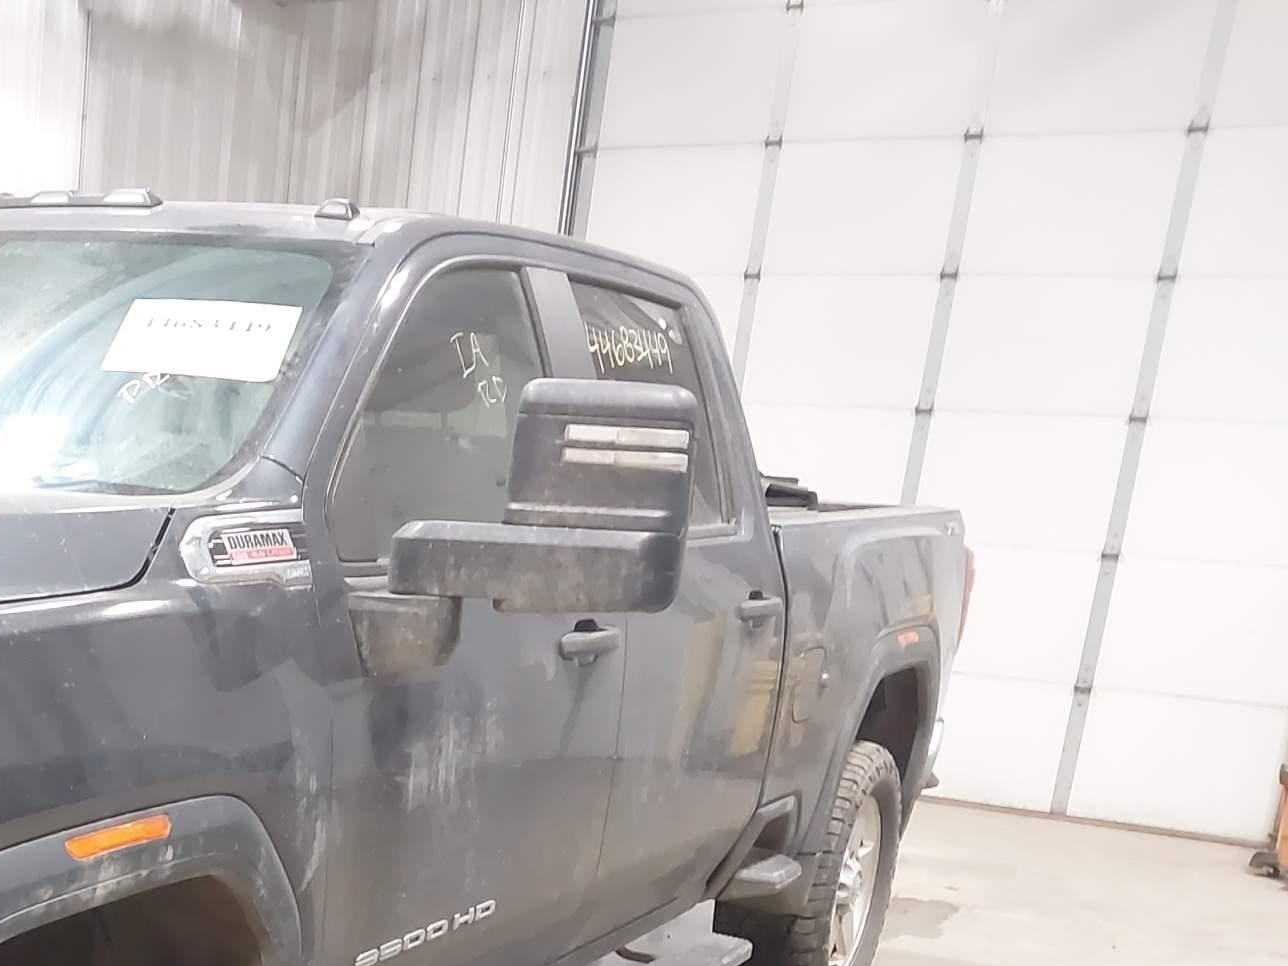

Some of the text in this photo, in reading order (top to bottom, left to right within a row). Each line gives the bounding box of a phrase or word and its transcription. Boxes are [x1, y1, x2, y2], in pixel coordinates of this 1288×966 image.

[584, 321, 673, 375] 44683449
[227, 531, 288, 550] DURAMAX
[452, 899, 496, 930] HD
